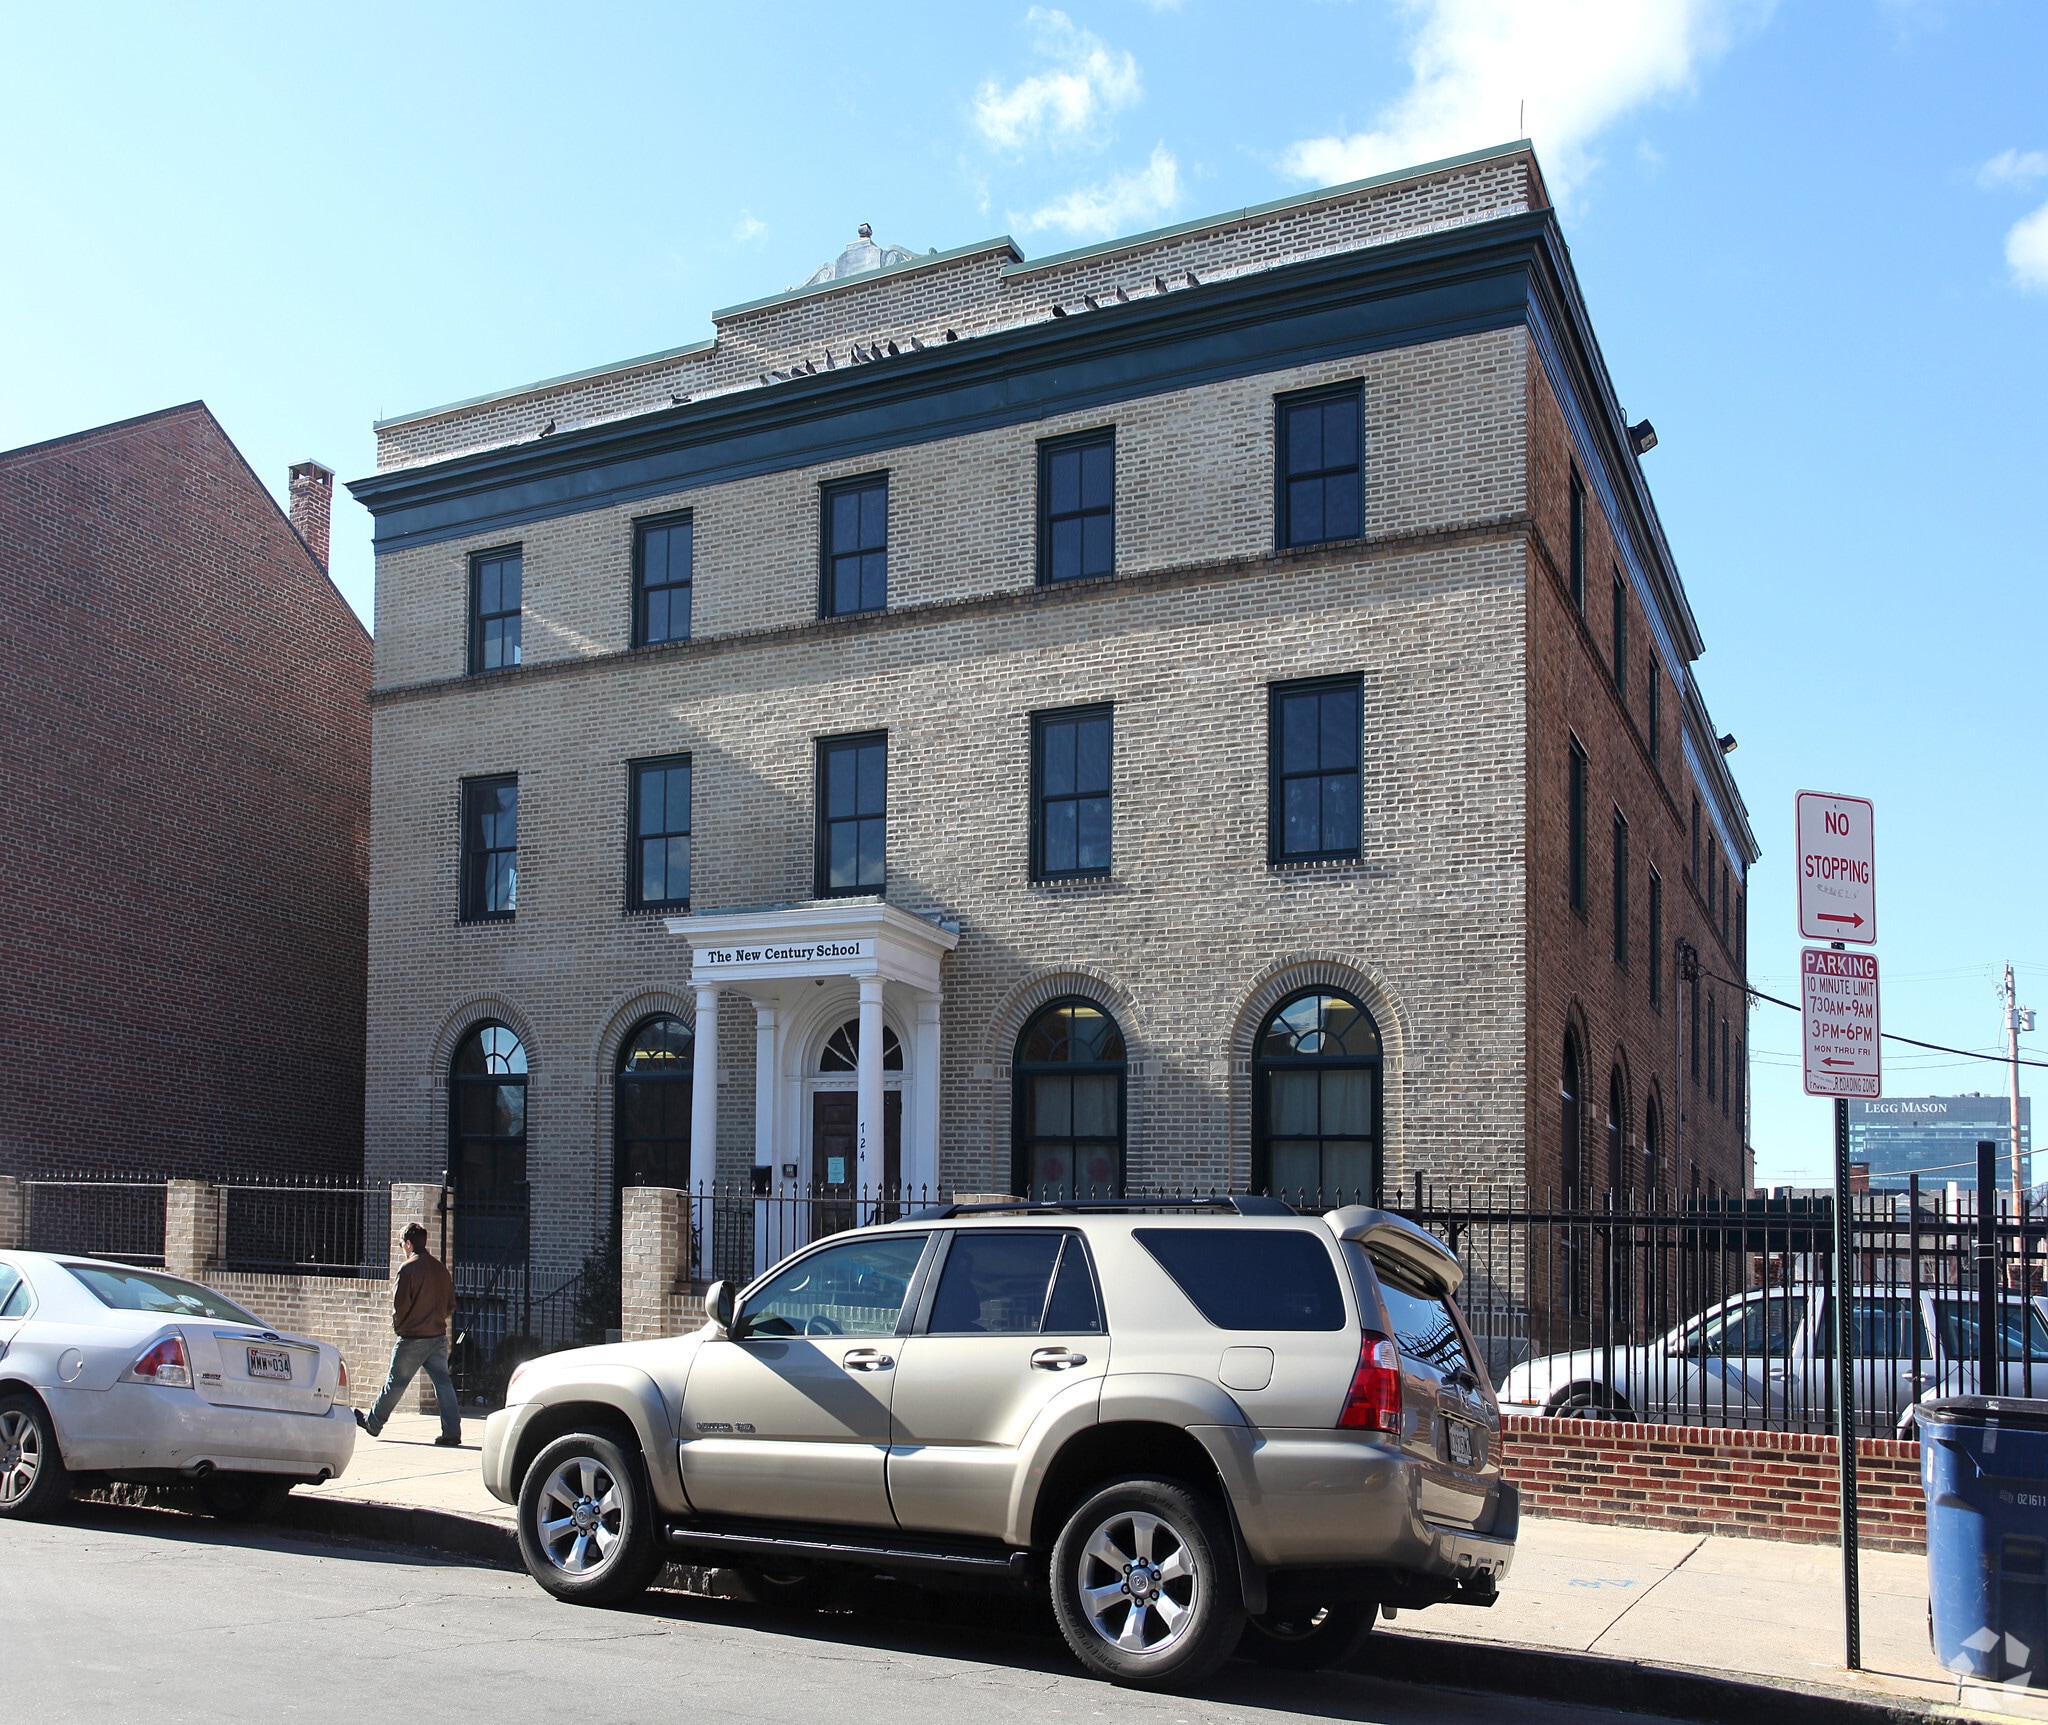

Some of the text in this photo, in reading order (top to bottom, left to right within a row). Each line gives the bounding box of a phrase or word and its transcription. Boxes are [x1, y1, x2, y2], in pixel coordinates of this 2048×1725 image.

[1825, 811, 1850, 836] NO
[1805, 854, 1869, 884] STOPPING
[708, 942, 860, 963] The New Century School
[1805, 952, 1875, 978] PARKING
[1807, 976, 1874, 997] 10 MINUTE LIMIT
[1812, 1019, 1873, 1042] 3PM-6PM
[1814, 1045, 1871, 1056] MON THRU FRI
[1862, 1078, 1876, 1093] ZONE
[1865, 1102, 1947, 1113] LEGG MASON
[2017, 1493, 2046, 1507] 021611
